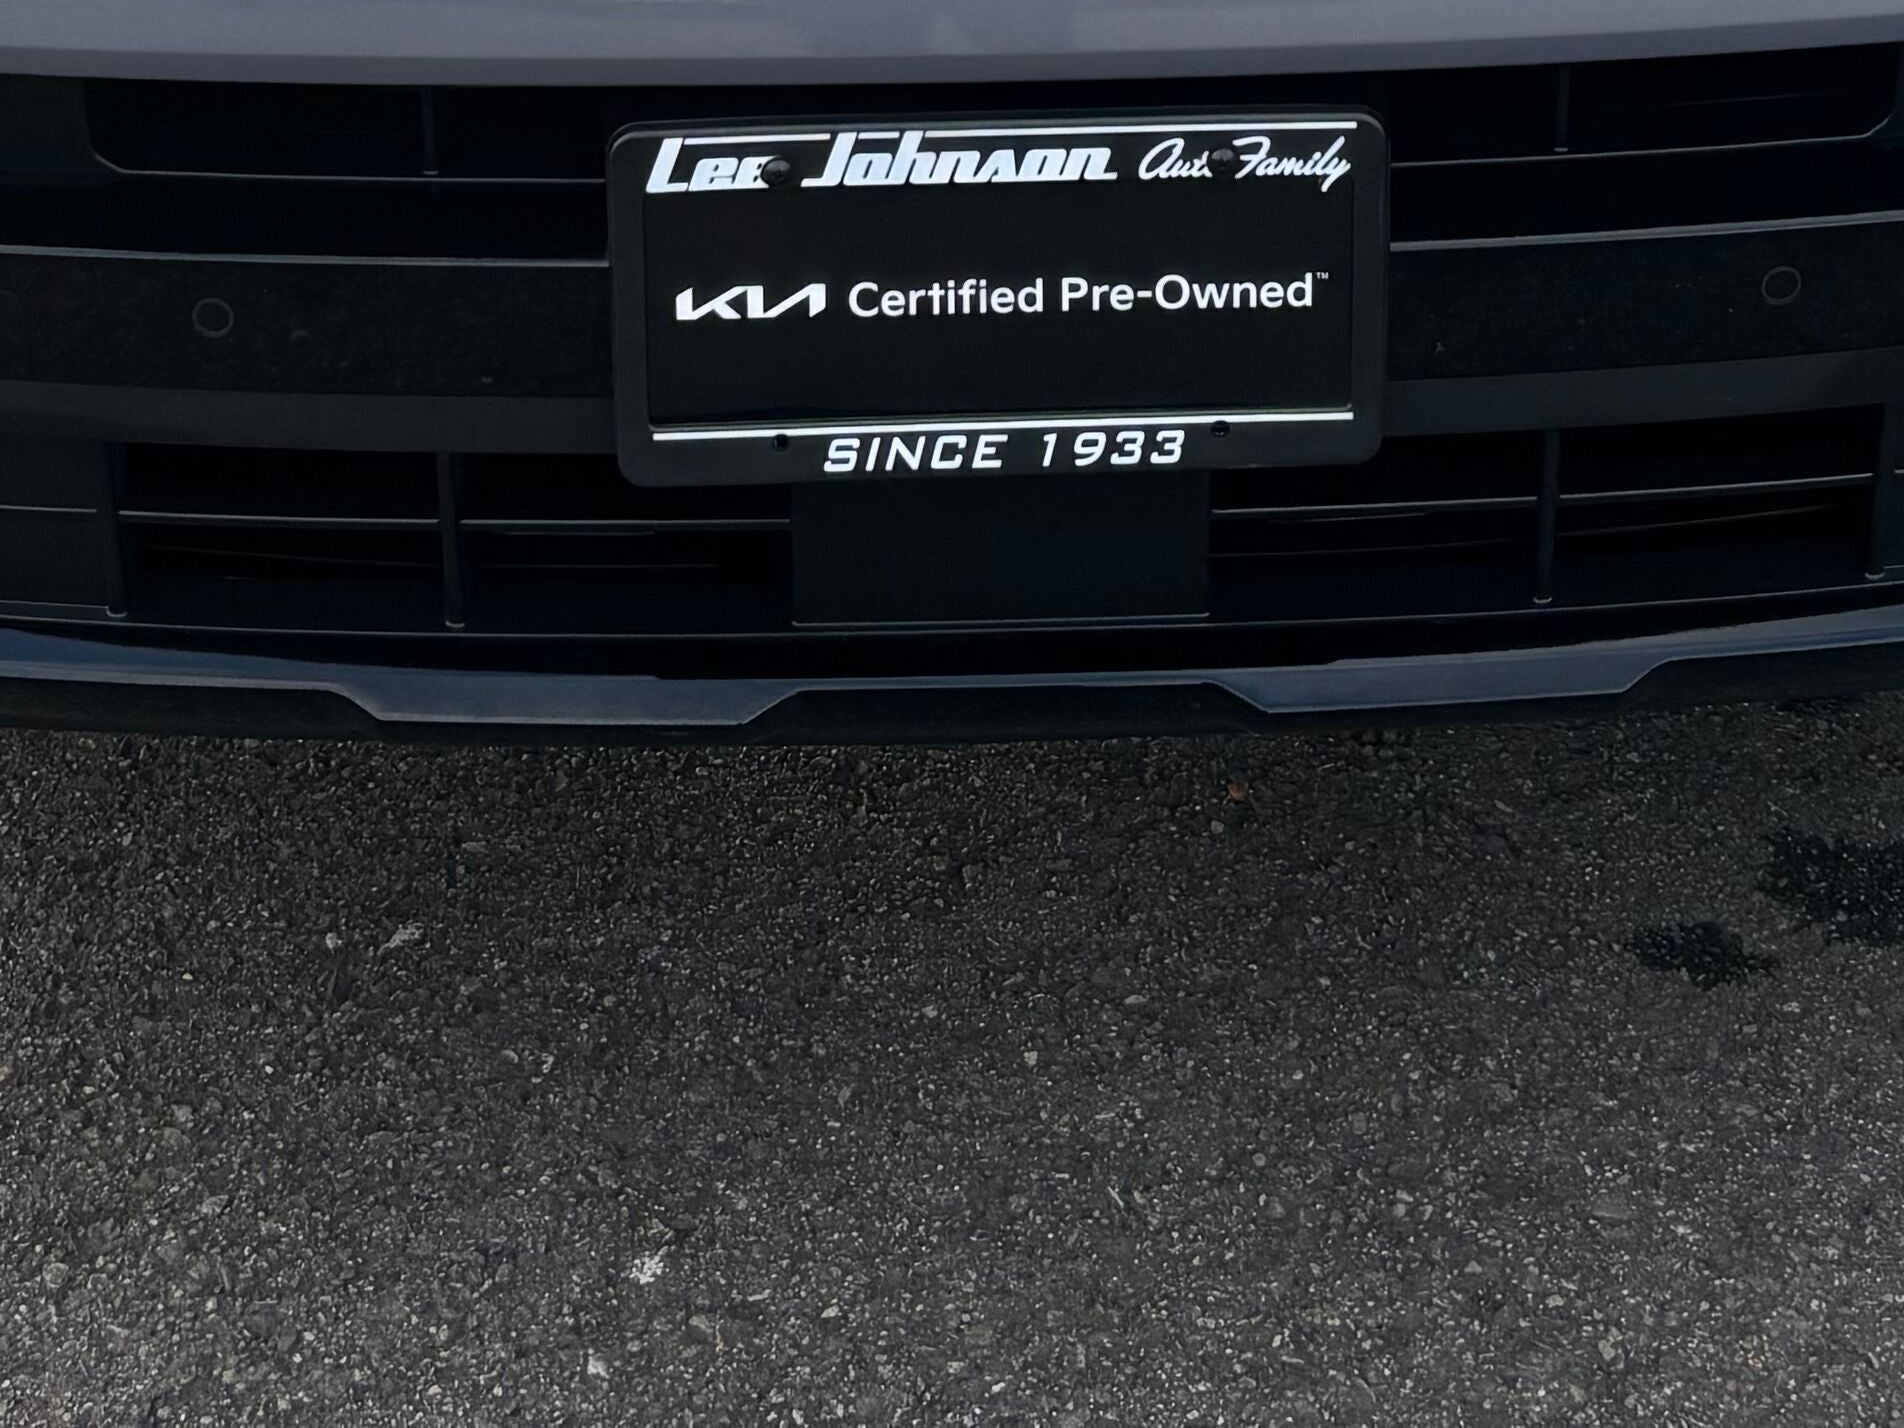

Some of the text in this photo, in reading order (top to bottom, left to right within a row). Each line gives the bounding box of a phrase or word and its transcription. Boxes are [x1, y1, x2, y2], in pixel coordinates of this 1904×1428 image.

[645, 129, 1118, 194] Lee Johnson
[1138, 135, 1351, 193] Aut Family
[675, 283, 827, 321] KIA
[848, 277, 1045, 319] Certified
[823, 429, 1186, 473] SINCE 1933
